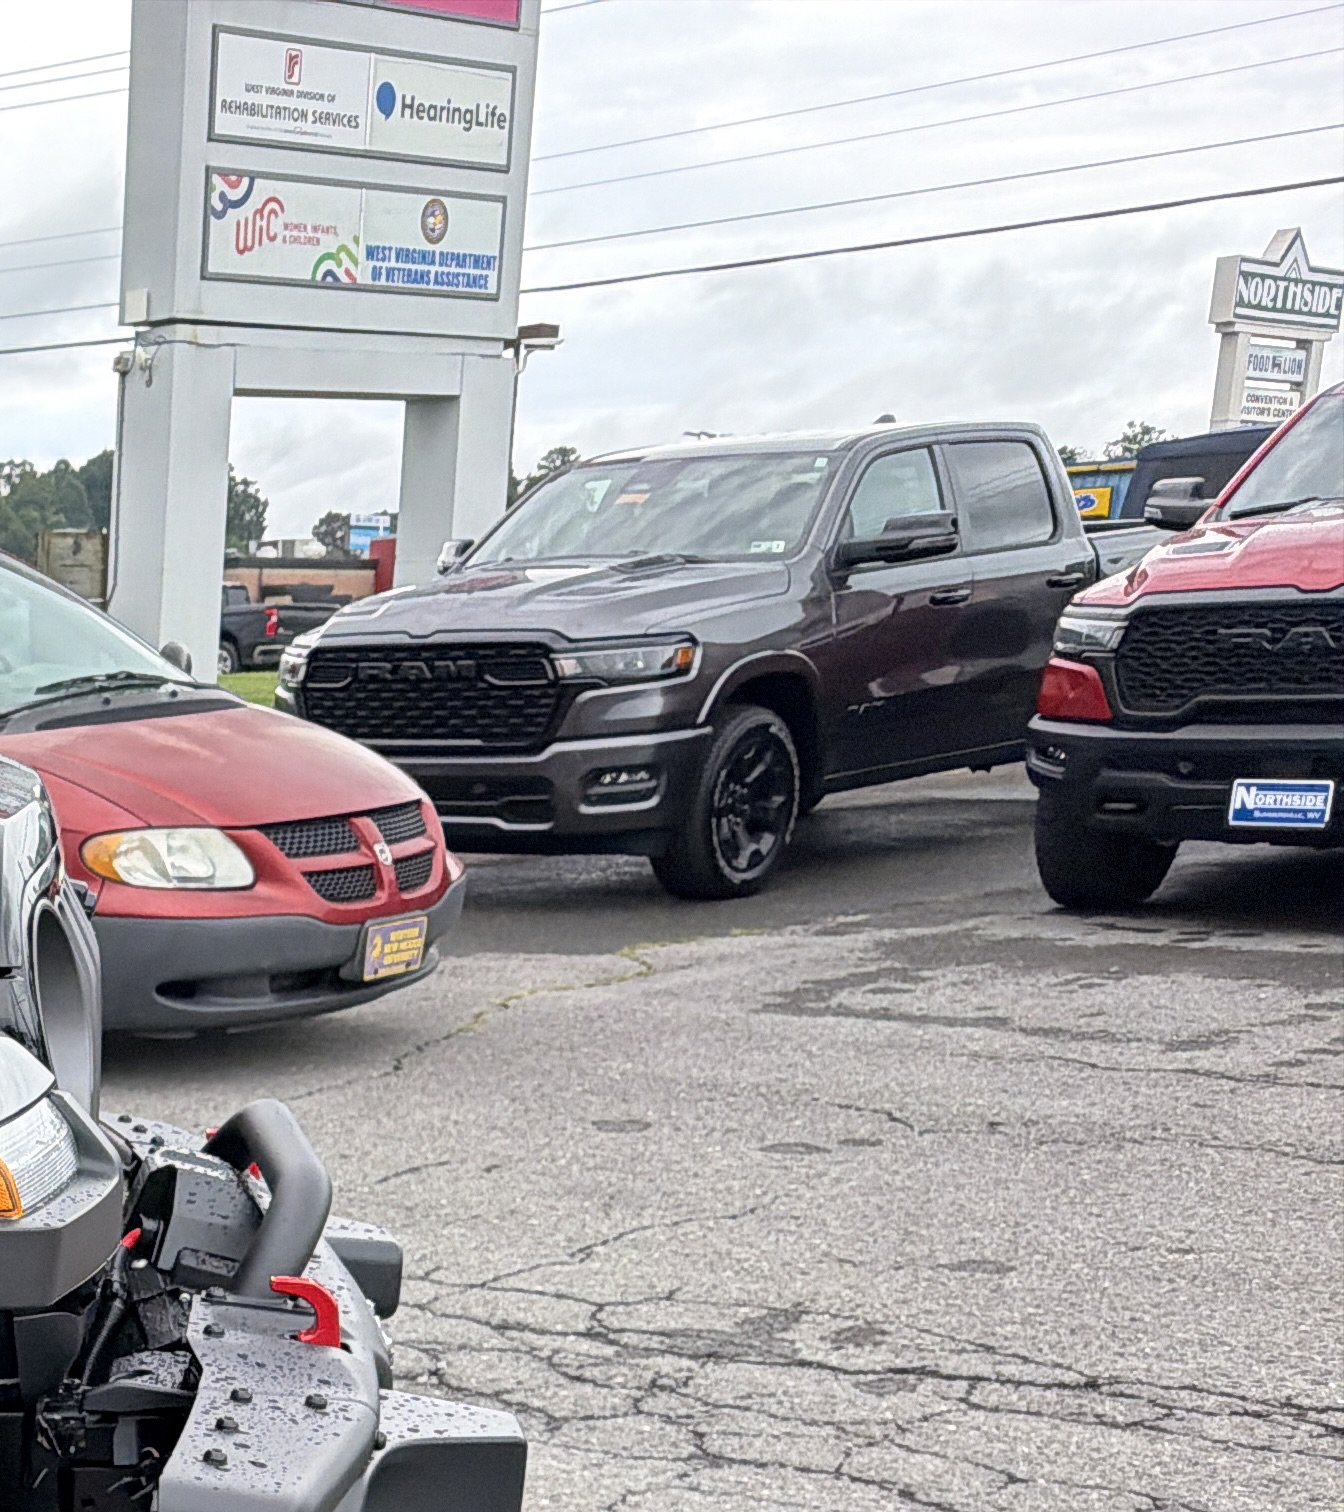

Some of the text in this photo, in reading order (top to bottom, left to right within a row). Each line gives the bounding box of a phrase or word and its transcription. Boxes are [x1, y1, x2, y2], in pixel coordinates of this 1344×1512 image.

[244, 82, 336, 103] WEST VIRGINIA DIVISION OF
[220, 98, 360, 130] REHABILITATION SERVICES
[401, 94, 506, 131] HearingLife
[366, 243, 497, 272] WEST VIRGINIA DEPARTMENT
[371, 264, 489, 290] OF VETERANS ASSISTANCE
[1236, 274, 1343, 315] NORTHSIDE
[1247, 353, 1303, 375] FOOD LION
[1246, 393, 1288, 405] CONVENTION
[357, 661, 475, 681] RAM
[1234, 785, 1326, 810] NORTHSIDE
